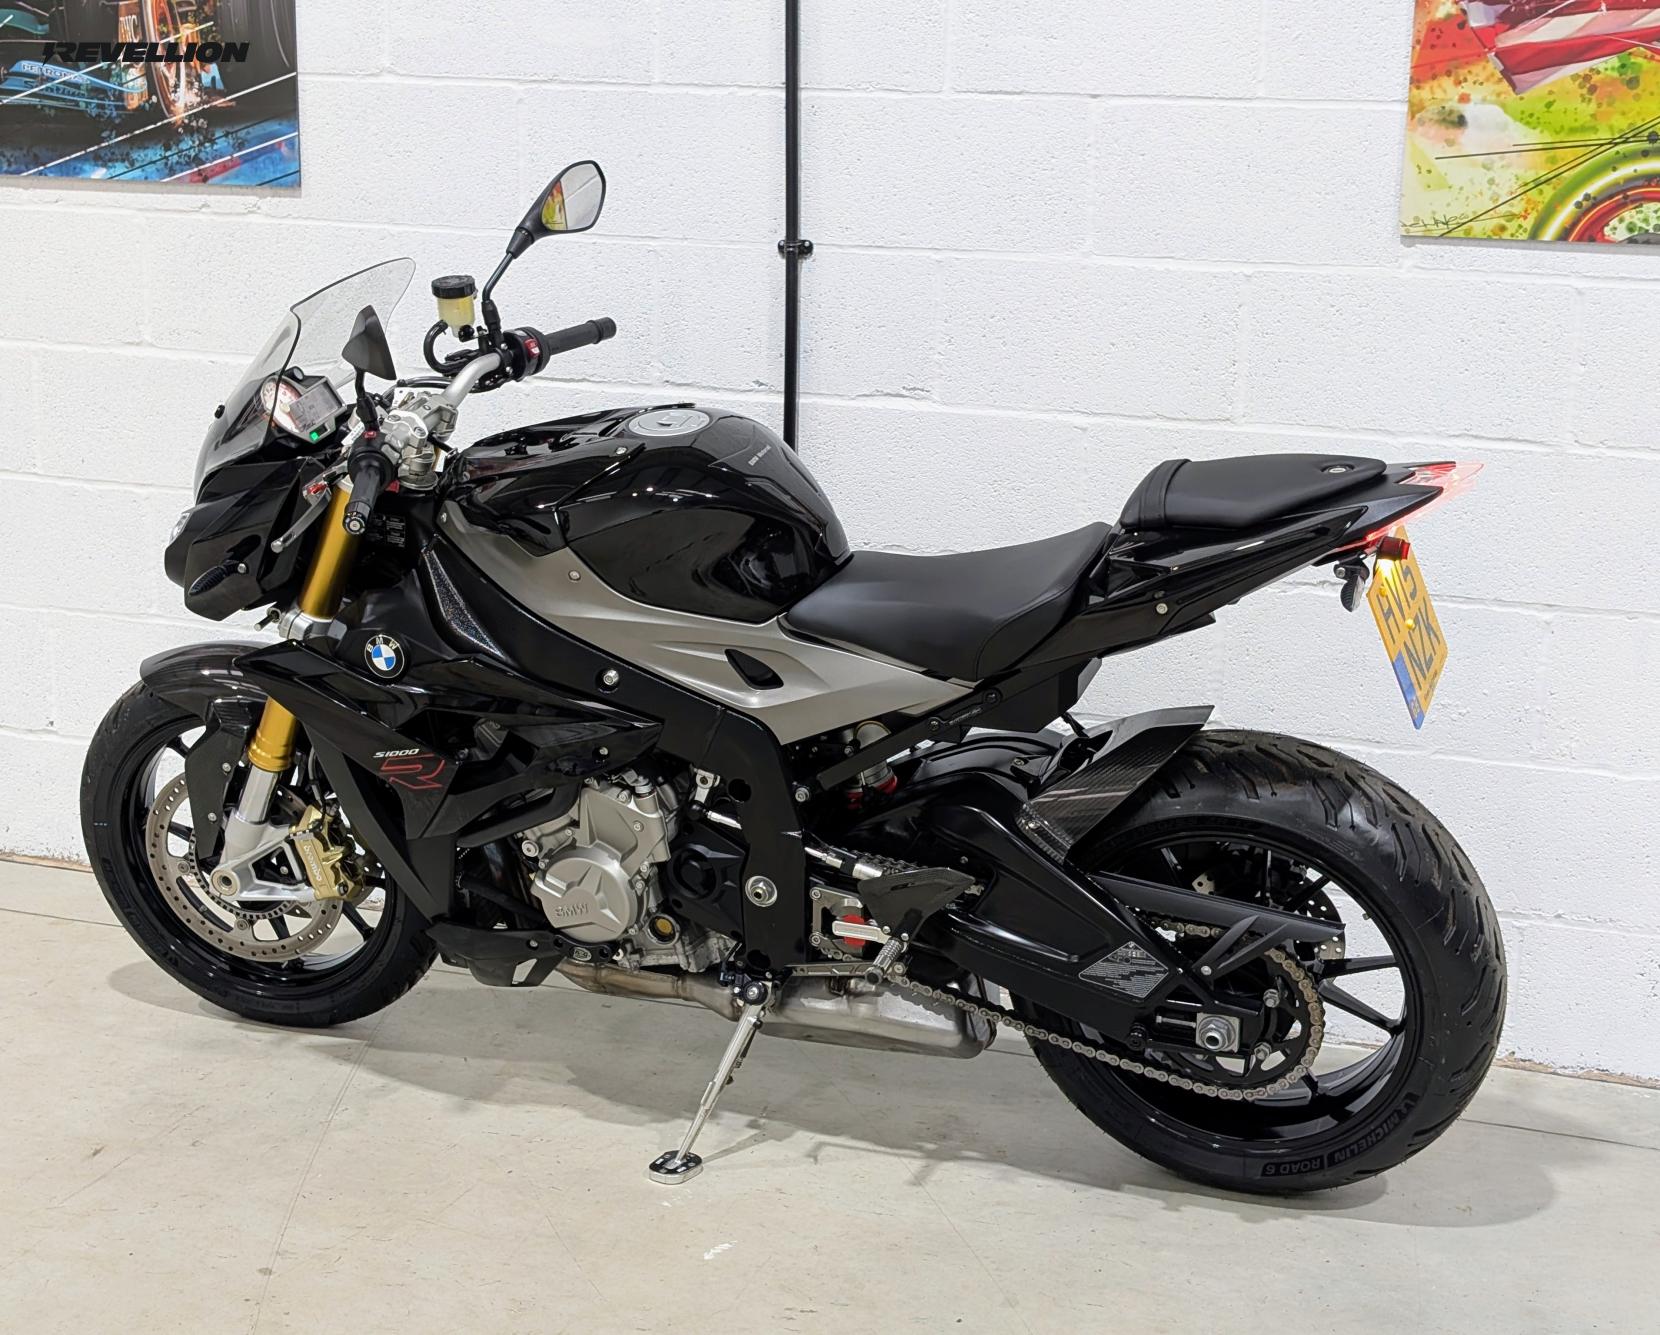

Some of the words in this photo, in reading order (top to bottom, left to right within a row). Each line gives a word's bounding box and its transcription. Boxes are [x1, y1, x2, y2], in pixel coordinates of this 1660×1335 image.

[366, 636, 399, 653] BMW
[1403, 597, 1441, 691] NZK
[373, 748, 420, 758] S1000
[303, 844, 322, 882] brembo
[555, 902, 590, 917] BMW
[1333, 1112, 1399, 1163] MICHELIN
[1265, 1165, 1277, 1175] 6
[1279, 1158, 1321, 1174] ROAD
